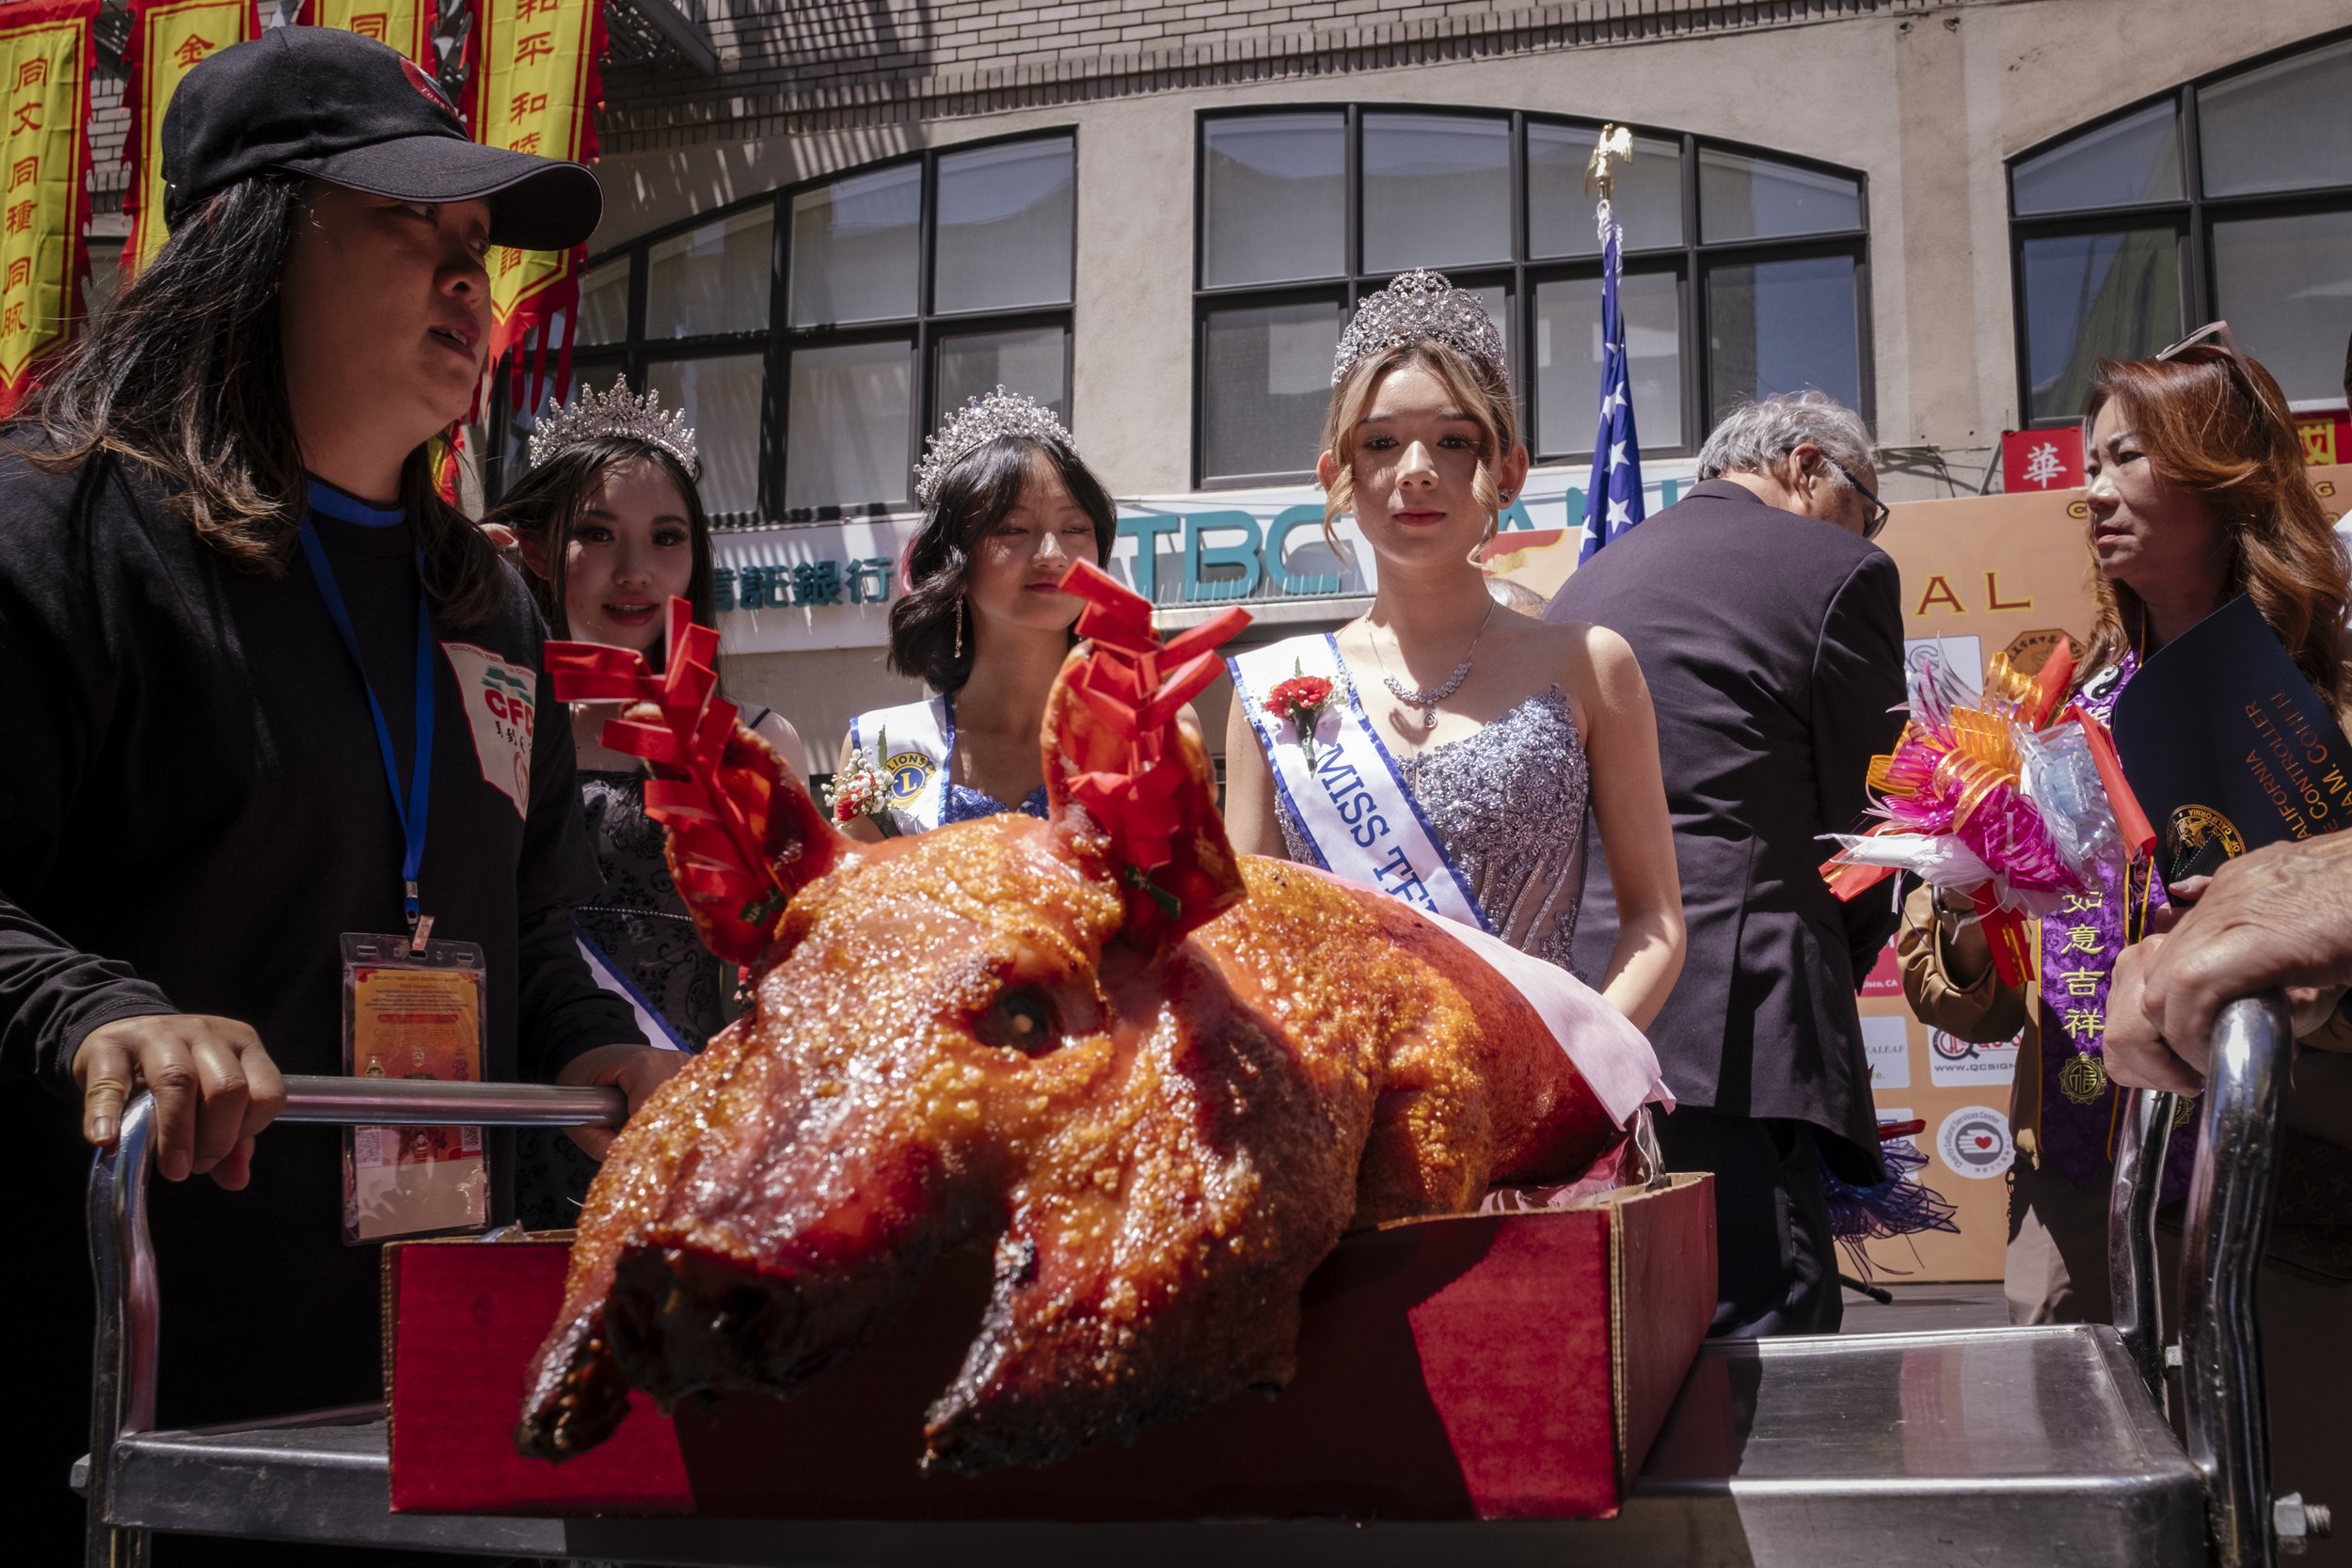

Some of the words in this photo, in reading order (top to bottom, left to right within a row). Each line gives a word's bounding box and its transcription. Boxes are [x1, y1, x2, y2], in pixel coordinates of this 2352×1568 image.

[174, 33, 215, 69] 金
[2021, 441, 2067, 489] 華
[1915, 570, 2033, 616] AL
[2270, 691, 2328, 765] COHEN
[886, 754, 925, 771] LIONS
[2244, 699, 2328, 820] CONTROLLER
[900, 771, 917, 794] L
[2244, 748, 2311, 840] ALIFORNIA
[1320, 743, 1391, 849] MISS
[1373, 846, 1439, 913] TE
[2188, 808, 2233, 835] CALIFORNIA
[1884, 979, 1899, 988] CA
[2060, 891, 2106, 1039] 如意吉祥
[1865, 1044, 1905, 1054] EALEAF
[1934, 1062, 2015, 1072] WWW.QCSIGN
[1944, 1123, 1956, 1148] Cultural
[1953, 1112, 1979, 1127] Services
[1979, 1111, 2001, 1124] Center
